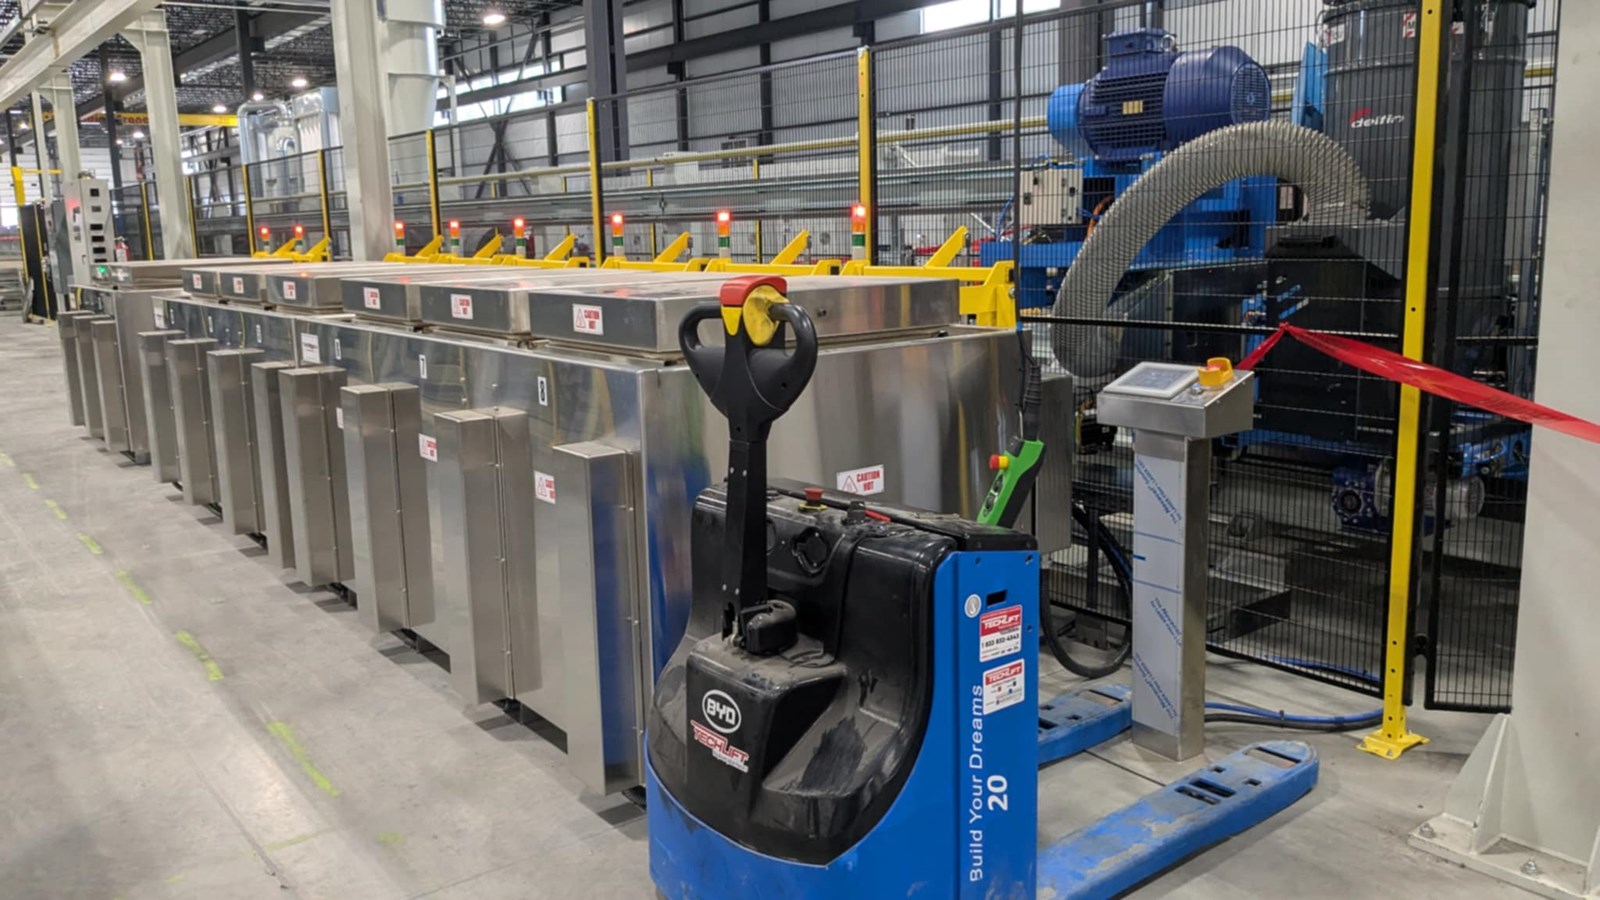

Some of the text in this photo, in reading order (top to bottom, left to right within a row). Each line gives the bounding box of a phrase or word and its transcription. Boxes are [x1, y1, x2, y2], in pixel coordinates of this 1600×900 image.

[540, 380, 546, 402] 8
[857, 470, 880, 482] CAUTION
[863, 481, 873, 491] HOT
[707, 698, 736, 725] BYD
[692, 721, 749, 763] TECHLIFT
[970, 684, 983, 882] Build Your Dreams
[987, 774, 1008, 811] 20
